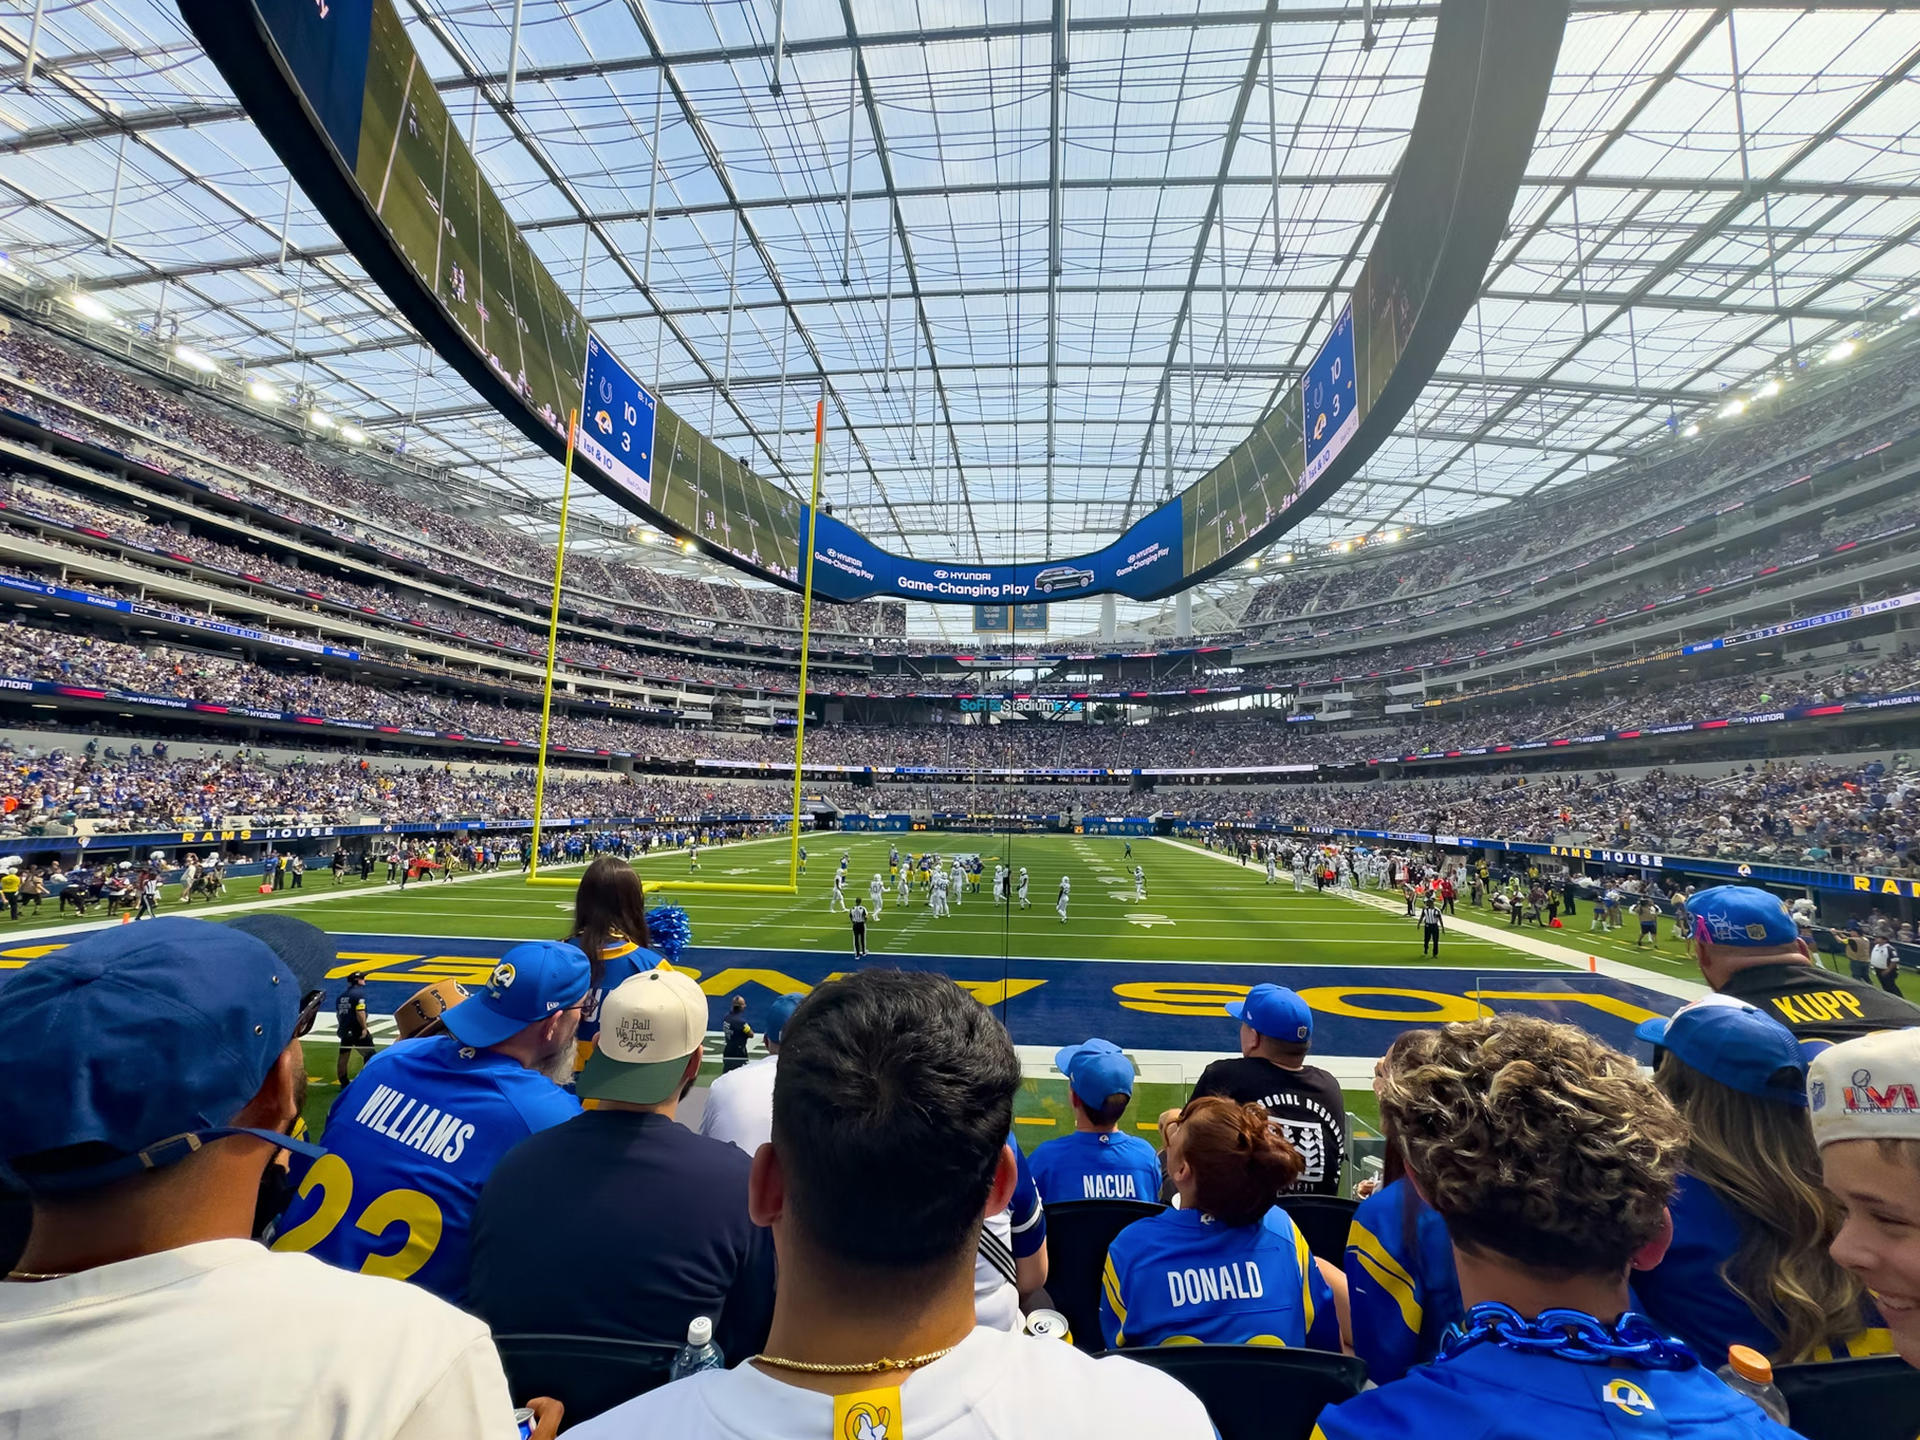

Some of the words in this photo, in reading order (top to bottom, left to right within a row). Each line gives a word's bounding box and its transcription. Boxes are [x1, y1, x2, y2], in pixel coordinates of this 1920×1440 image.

[1330, 356, 1341, 385] 10
[1332, 394, 1340, 418] 3
[623, 402, 637, 428] 10
[620, 431, 631, 454] 3
[582, 439, 594, 456] 1st
[595, 449, 602, 463] &
[602, 458, 613, 471] 10
[837, 552, 862, 567] HYUNDAI
[1157, 547, 1170, 562] Play
[815, 551, 861, 578] Game-Changing
[861, 572, 874, 581] Play
[950, 571, 991, 581] HYUNDAI
[898, 576, 999, 597] Game-Changing
[1002, 583, 1030, 596] Play
[86, 596, 117, 608] RAMS
[1867, 605, 1879, 613] 1st
[1890, 599, 1901, 607] 10
[139, 697, 167, 706] PALISADE
[168, 701, 187, 709] Hybrid
[960, 700, 988, 711] SoFi
[1003, 700, 1054, 711] Stadium
[1879, 697, 1912, 706] PALISADE
[249, 710, 281, 719] HYUNDAI
[1748, 713, 1784, 724] HYUNDAI
[182, 830, 251, 842] RAMS
[266, 827, 334, 839] HOUSE
[1550, 846, 1592, 859] RAMS
[1602, 850, 1663, 867] HOUSE
[1771, 990, 1865, 1024] KUPP
[619, 1017, 629, 1029] In
[631, 1019, 650, 1030] Ball
[615, 1027, 627, 1040] We
[628, 1030, 656, 1042] Trust.
[618, 1039, 648, 1055] Enjoy
[1256, 1093, 1300, 1109] SOCIAL
[1842, 1083, 1920, 1112] LVI
[354, 1083, 476, 1164] WILLIAMS
[1083, 1174, 1137, 1199] NACUA
[1167, 1261, 1264, 1308] DONALD
